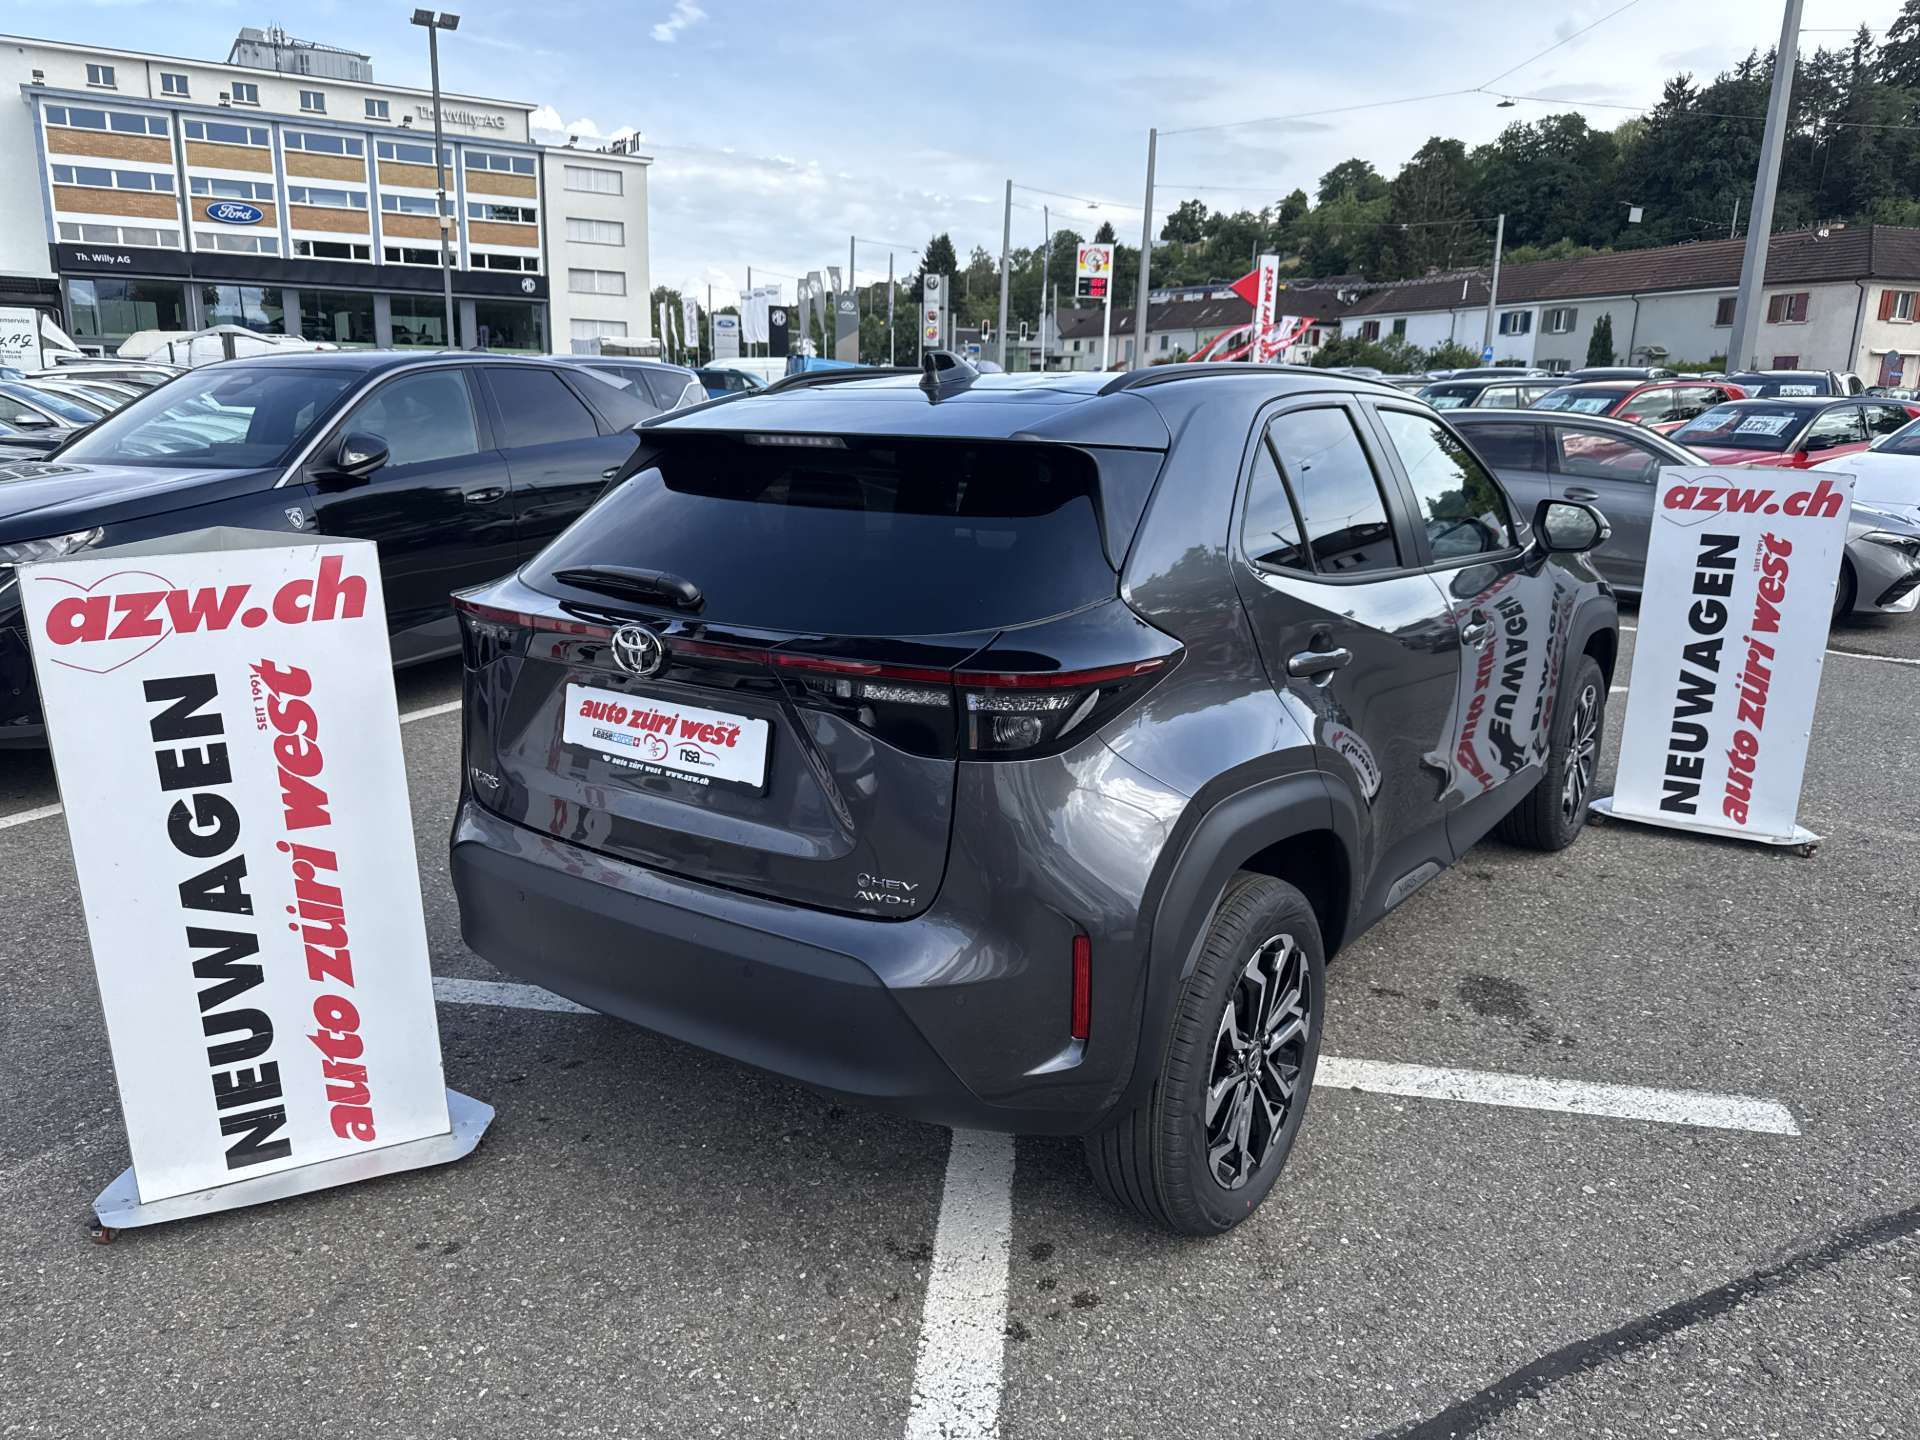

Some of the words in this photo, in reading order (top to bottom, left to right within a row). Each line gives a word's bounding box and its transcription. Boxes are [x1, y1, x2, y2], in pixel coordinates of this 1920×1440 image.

[444, 108, 479, 129] Willy
[484, 114, 505, 129] AG
[217, 204, 252, 220] Ford
[1817, 229, 1830, 238] 48
[75, 252, 90, 262] Th.
[92, 253, 115, 265] Willy
[116, 255, 131, 264] AG
[1663, 480, 1844, 518] azw.ch
[46, 555, 367, 645] azw.ch
[1752, 532, 1793, 633] west
[250, 674, 264, 702] 1991
[1659, 533, 1740, 815] NEUWAGEN
[1734, 635, 1775, 732] züri
[255, 706, 268, 731] SEIT
[579, 699, 628, 725] auto
[627, 708, 680, 736] züri
[680, 718, 741, 748] west
[249, 658, 332, 830] west
[680, 748, 700, 764] nsa
[611, 757, 628, 767] auto
[628, 760, 644, 771] züri
[644, 766, 662, 775] west
[1723, 729, 1759, 825] auto
[854, 890, 916, 907] AWD-i
[871, 876, 919, 892] HEV
[143, 673, 292, 1170] NEUWAGEN
[276, 840, 355, 988] züri
[306, 994, 376, 1142] auto
